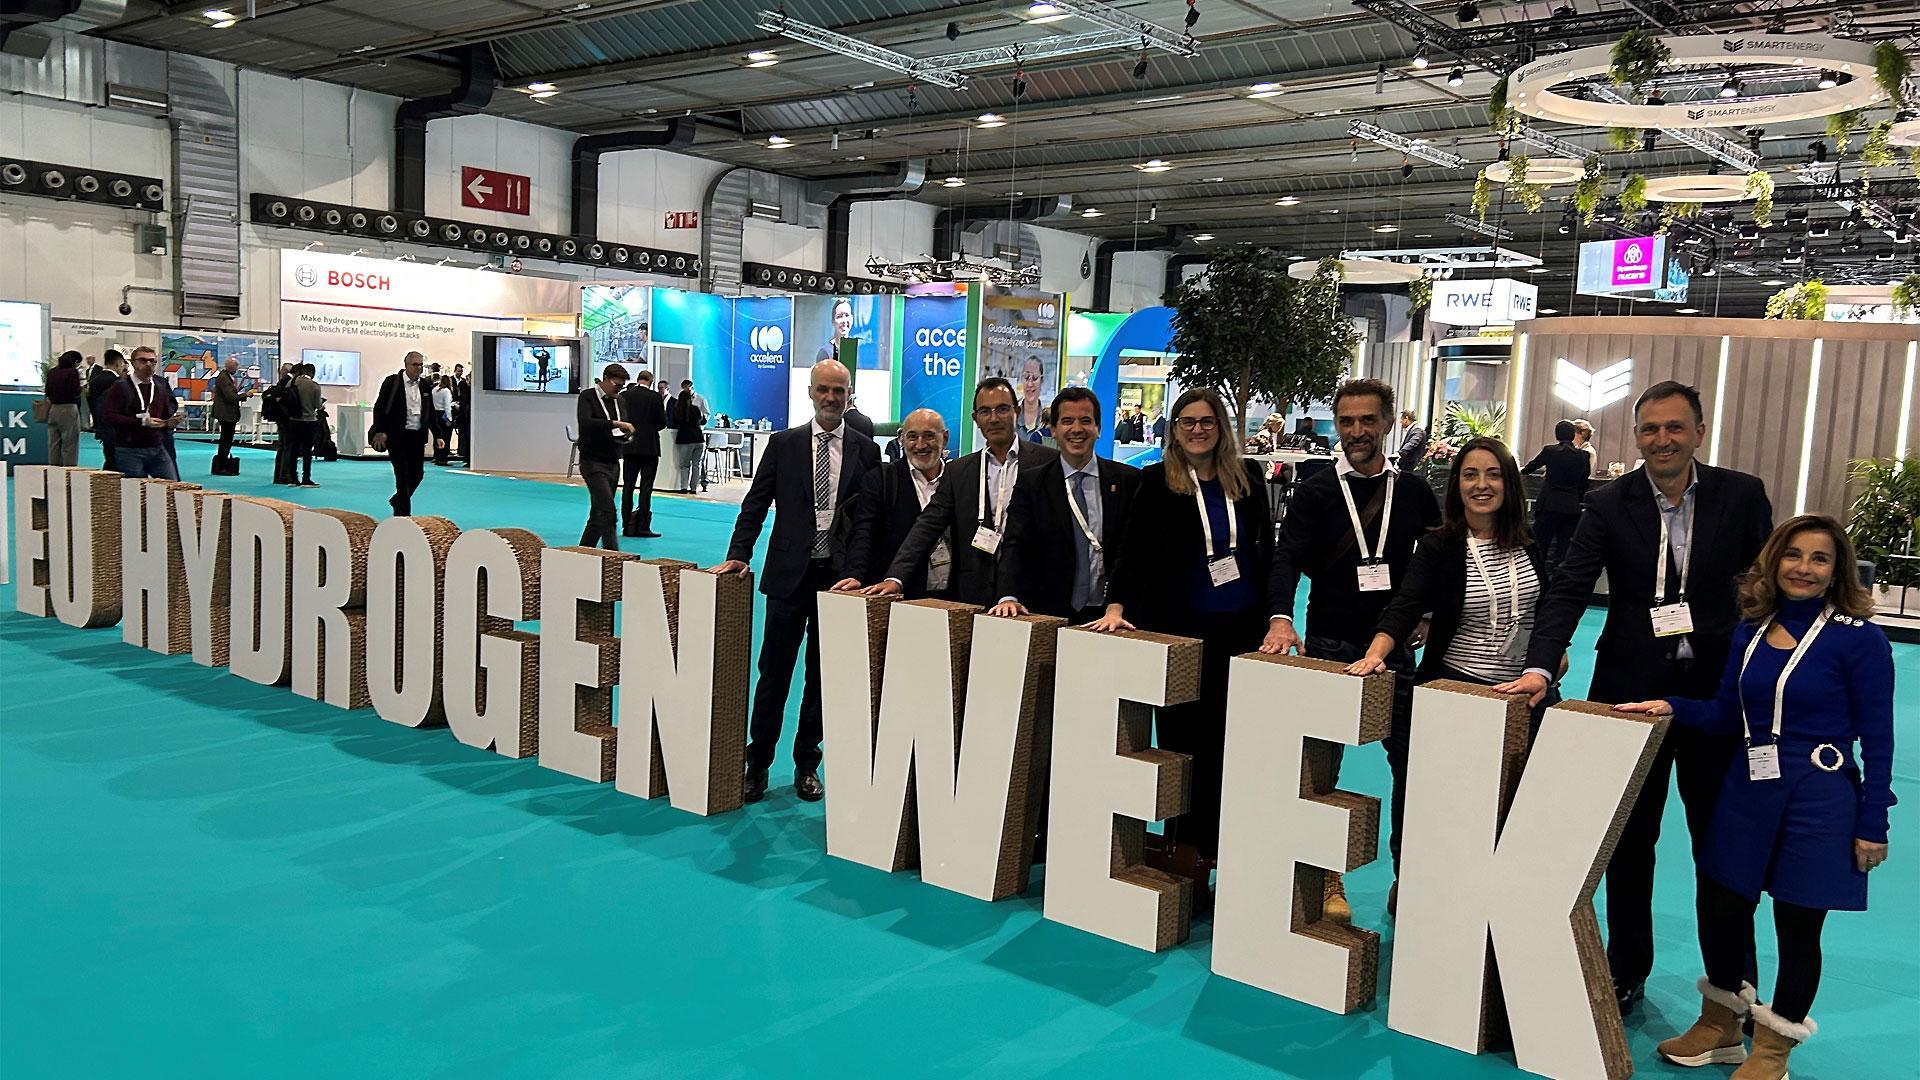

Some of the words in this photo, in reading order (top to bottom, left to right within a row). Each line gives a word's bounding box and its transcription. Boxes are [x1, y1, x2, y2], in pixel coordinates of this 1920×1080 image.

[1747, 40, 1825, 51] SMARTENERGY
[1706, 105, 1777, 117] SMARTENERGY
[328, 270, 391, 290] BOSCH
[1447, 293, 1493, 307] RWE
[1513, 294, 1532, 312] RWE
[300, 314, 322, 323] Make
[323, 315, 359, 327] hydrogen
[360, 320, 377, 328] your
[379, 320, 405, 329] climate
[406, 323, 427, 332] game
[427, 324, 455, 334] changer
[300, 324, 317, 333] with
[318, 324, 341, 334] Bosch
[342, 326, 358, 335] PEM
[359, 328, 398, 340] electrolysis
[399, 331, 420, 340] stacks
[987, 323, 1028, 337] Guadalajara
[923, 352, 961, 377] the
[14, 465, 94, 628] EU
[121, 478, 718, 816] HYDROGEN
[817, 590, 1660, 1080] WEEK
